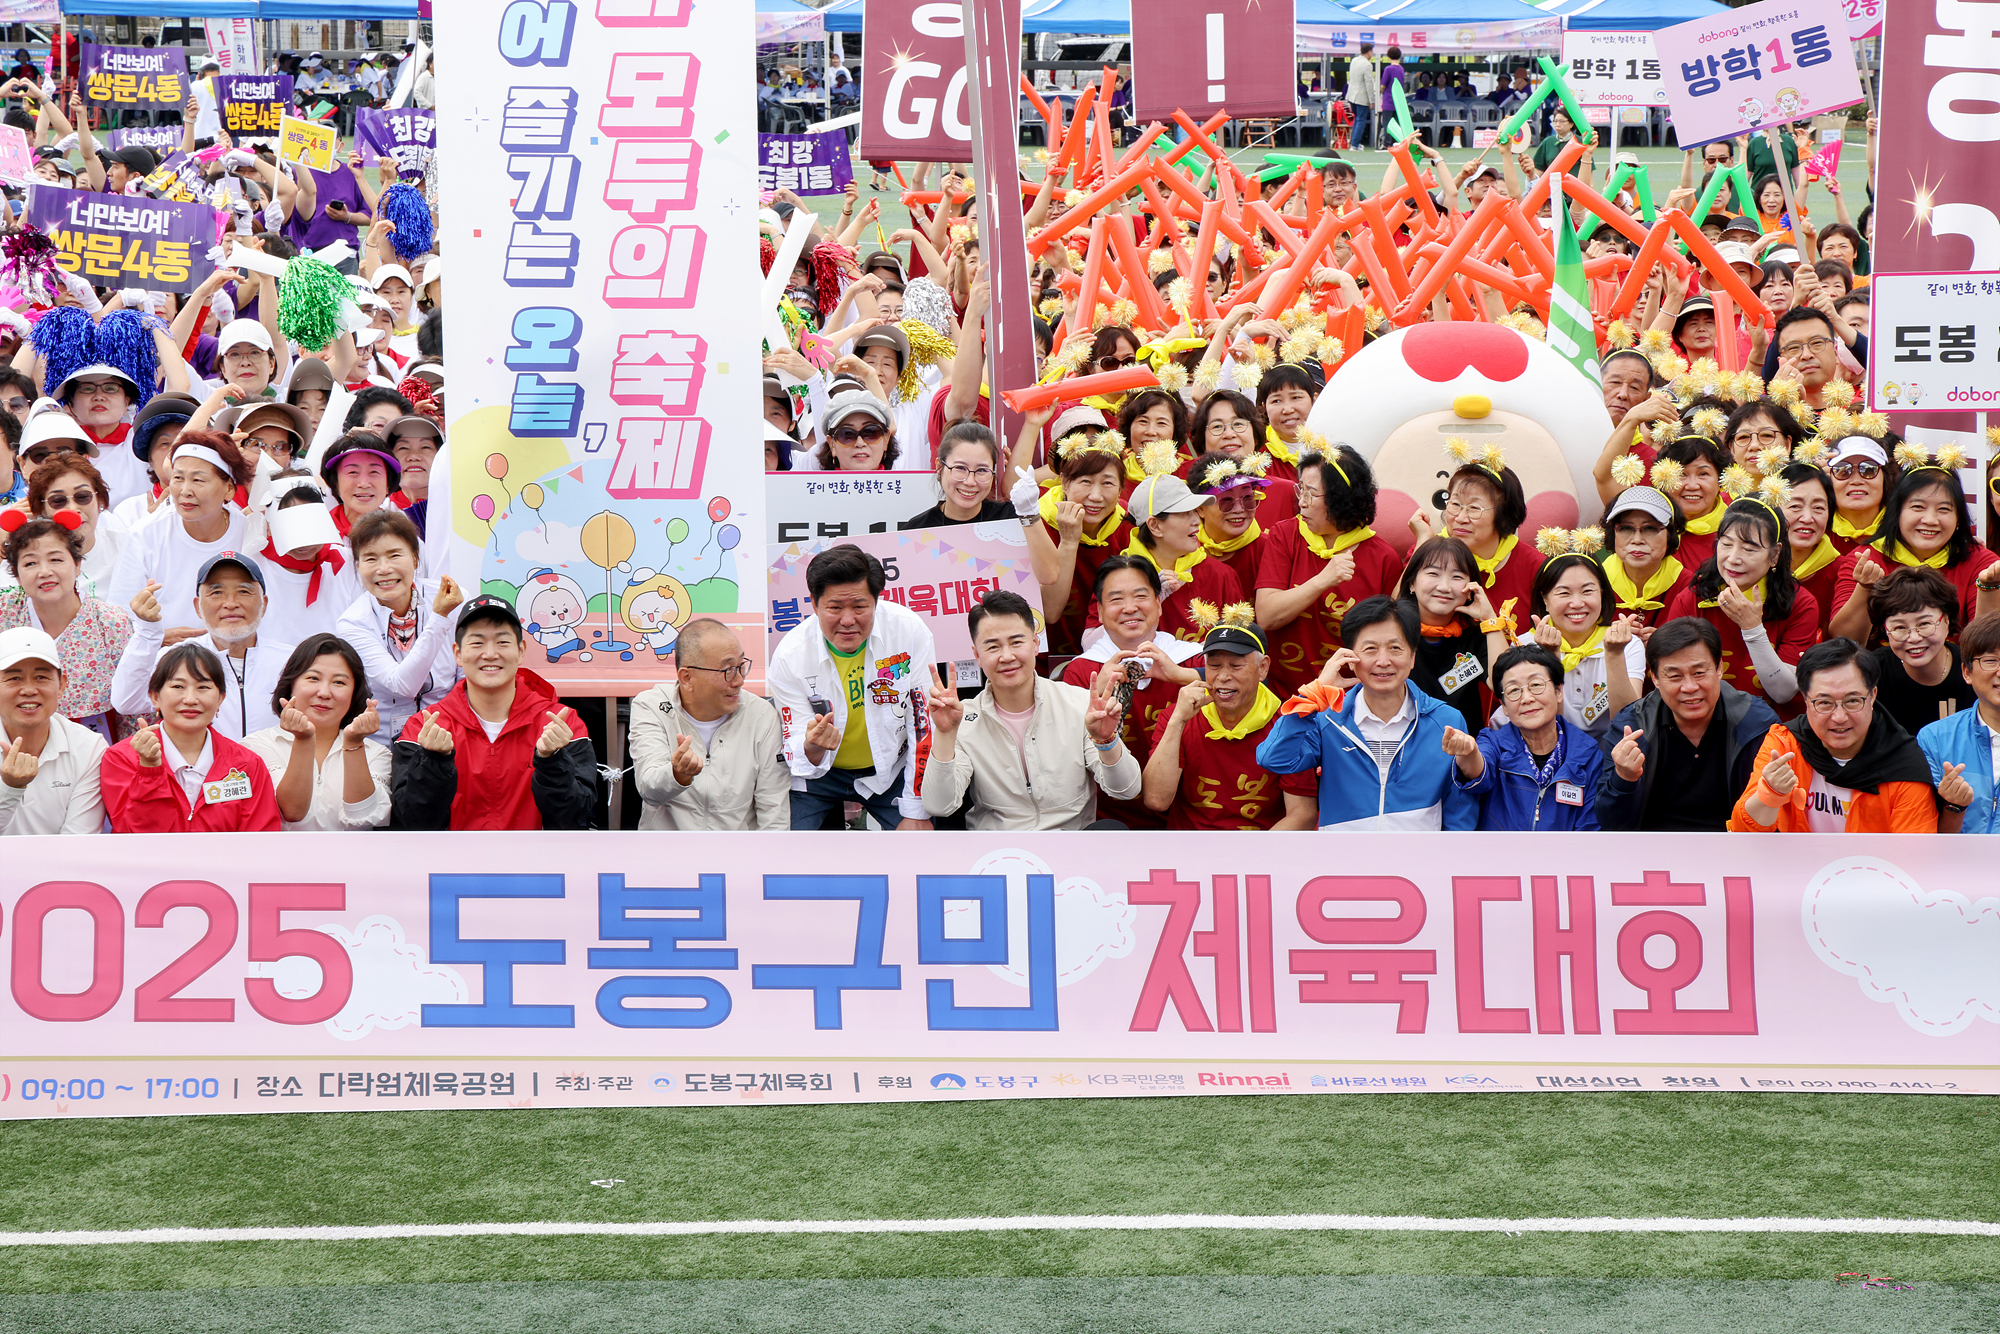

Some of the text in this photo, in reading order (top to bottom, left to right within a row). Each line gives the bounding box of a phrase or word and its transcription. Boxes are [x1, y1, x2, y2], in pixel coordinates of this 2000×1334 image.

[1698, 26, 1738, 44] dobong
[103, 52, 164, 72] 너만보여!
[1572, 58, 1661, 80] 방학 1동
[1680, 24, 1832, 97] 방학1동
[87, 72, 182, 103] 쌍문4동
[231, 82, 275, 100] 너만보여!
[1598, 92, 1634, 102] dobong
[225, 102, 284, 131] 쌍문4동
[389, 115, 435, 142] 최강
[768, 140, 814, 164] 최강
[500, 86, 581, 287] 즐기는
[598, 52, 707, 309] 모두의
[758, 165, 833, 190] 도봉1동
[70, 200, 170, 236] 너만보여!
[48, 229, 192, 283] 쌍문4동
[1927, 283, 1949, 296] 같이
[1952, 280, 1978, 296] 변화,
[1894, 325, 1976, 363] 도봉
[504, 306, 607, 452] 오늘,
[606, 330, 712, 499] 축제
[806, 480, 902, 495] 같이 변화, 행복한 도봉
[875, 652, 911, 670] SEOUL
[877, 659, 911, 680] GTX
[223, 785, 247, 798] 강혜란
[0, 869, 1759, 1036] 025 도봉구민 체육대회
[21, 1078, 105, 1100] 09:00
[145, 1077, 219, 1099] 17:00
[256, 1071, 515, 1098] 장소 다락원체육공원
[684, 1072, 833, 1092] 도봉구체육회
[877, 1075, 1040, 1089] 후원 도봉구
[1197, 1072, 1291, 1086] Rinnai
[1391, 1076, 1428, 1087] 병원
[1837, 1080, 1960, 1090] 990-4141~2
